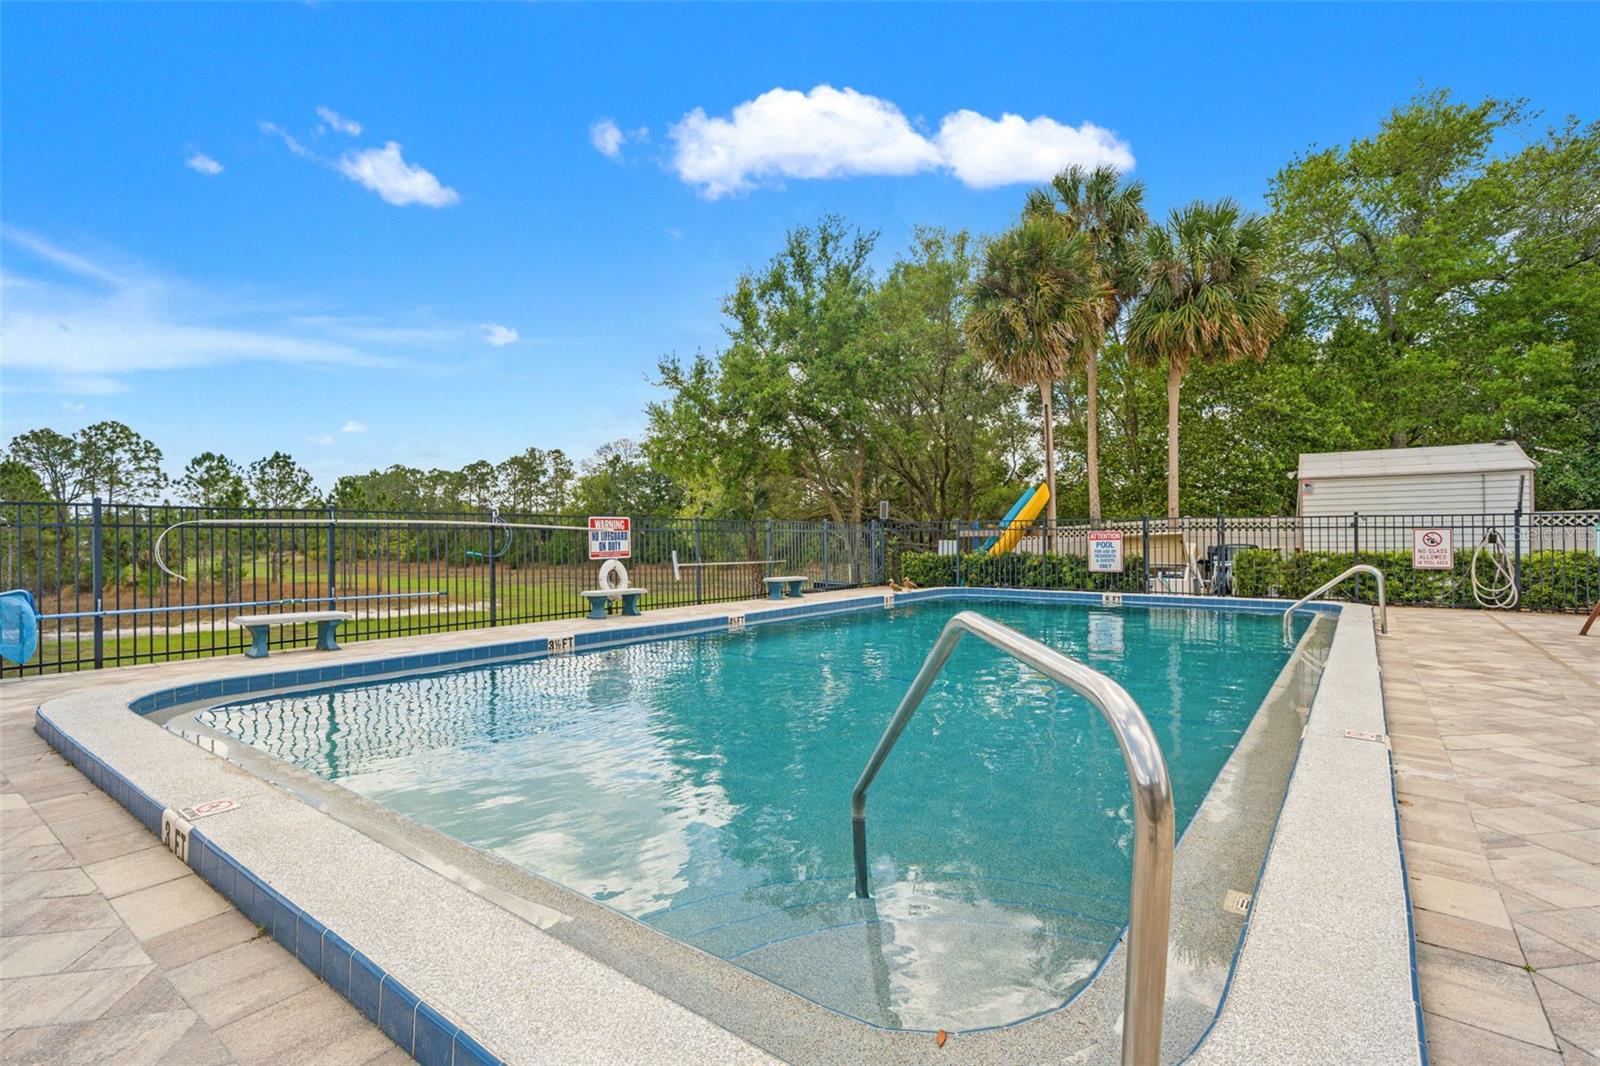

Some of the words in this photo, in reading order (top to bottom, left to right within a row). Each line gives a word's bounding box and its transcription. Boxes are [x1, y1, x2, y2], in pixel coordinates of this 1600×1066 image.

[594, 520, 624, 529] WARNING
[592, 532, 599, 541] NO
[601, 532, 627, 540] LIFEGUARD
[599, 542, 606, 550] ON
[608, 542, 620, 550] DUTY
[562, 637, 573, 648] FT
[165, 820, 171, 848] 3
[175, 828, 186, 862] FT
